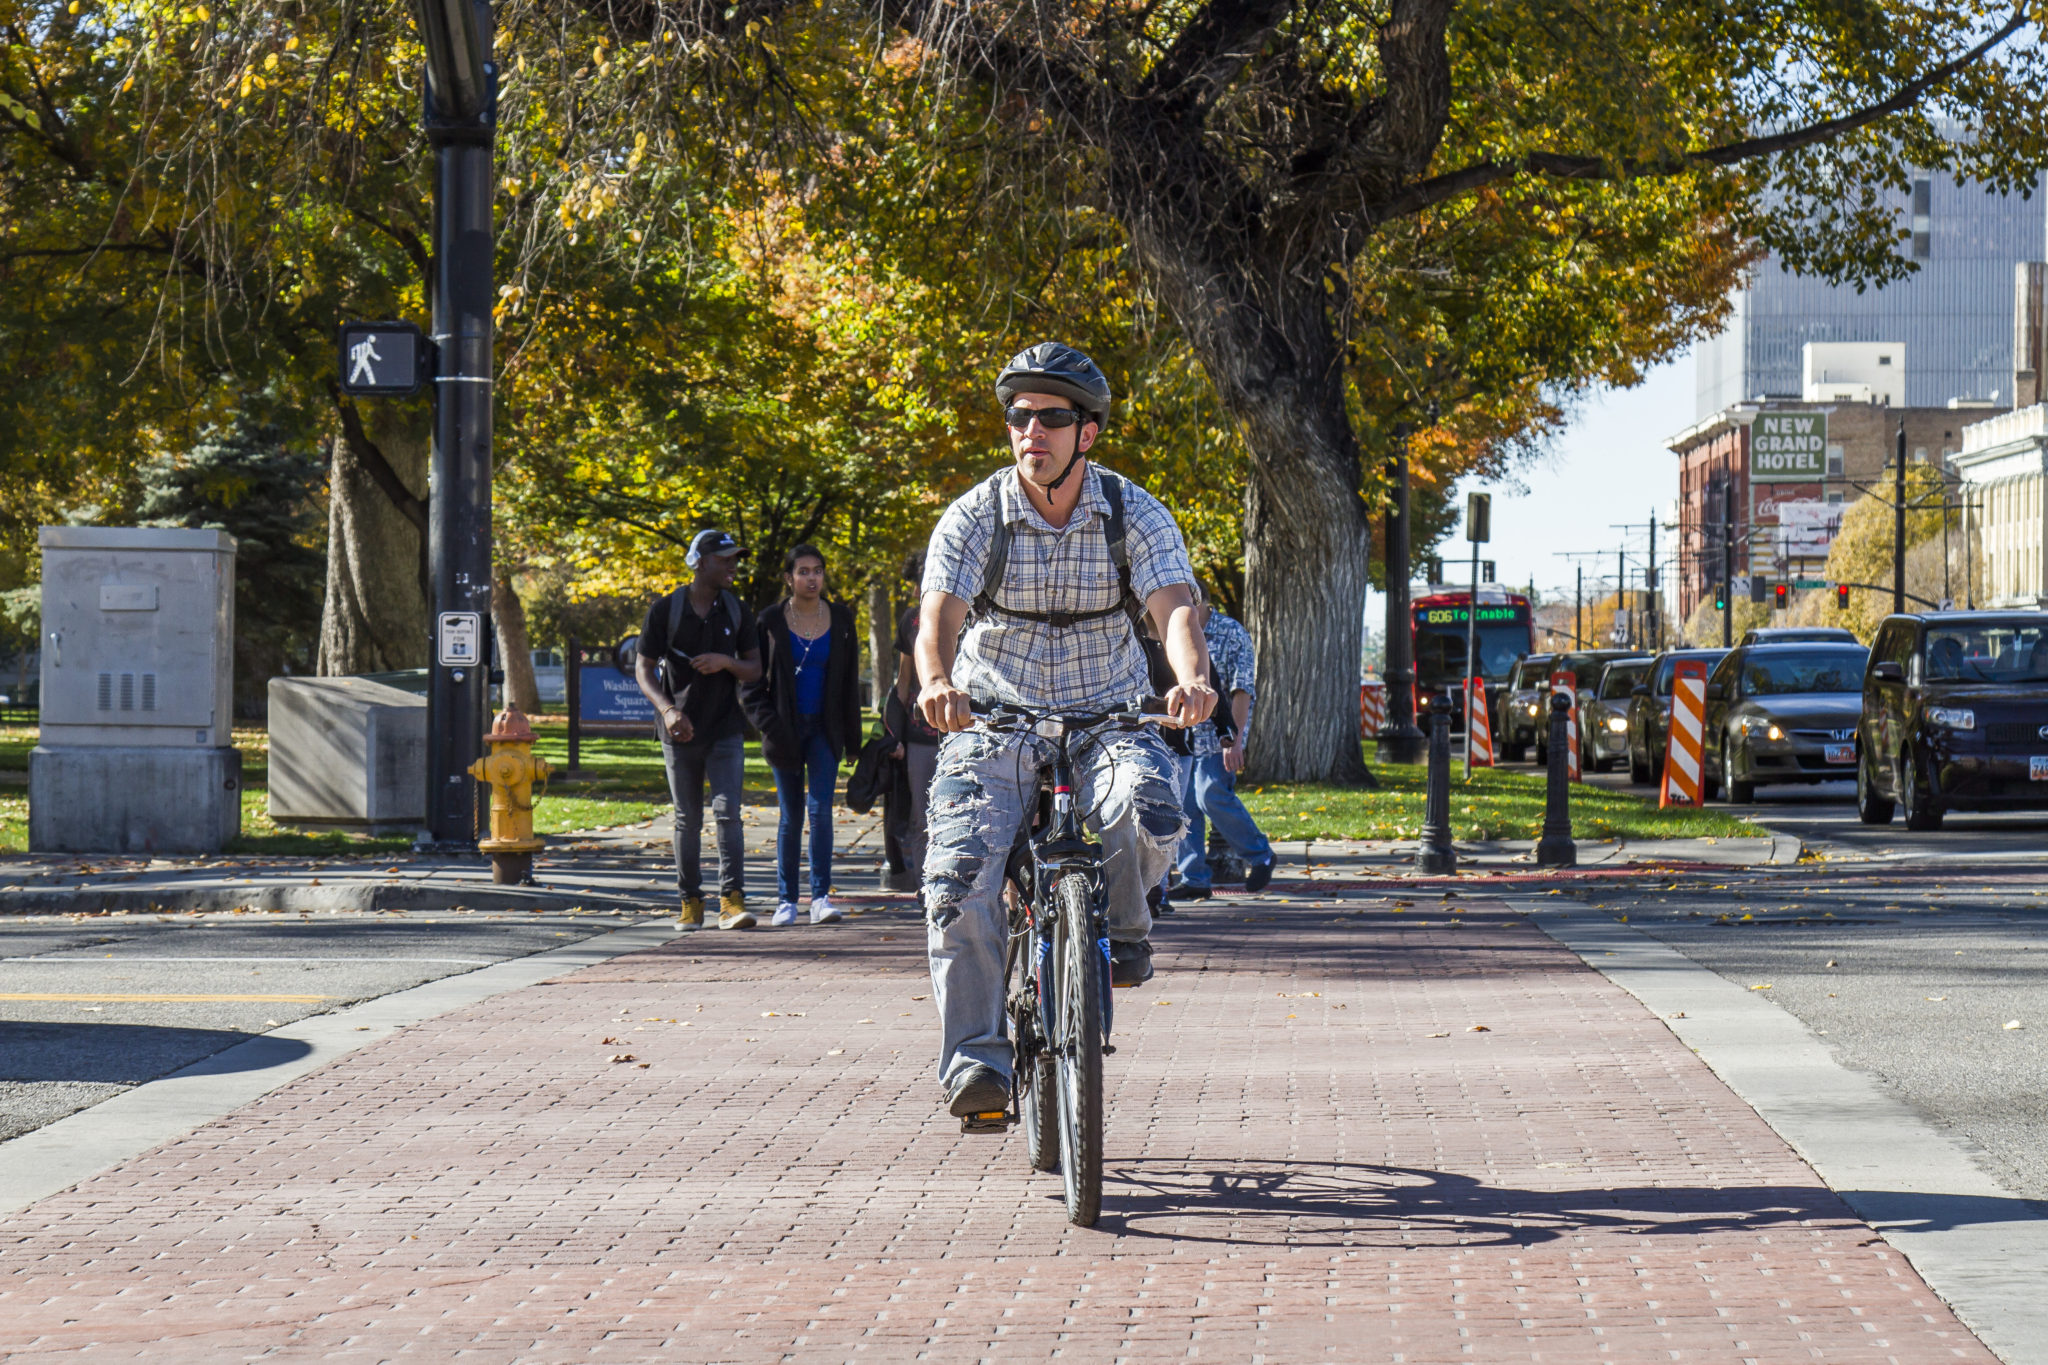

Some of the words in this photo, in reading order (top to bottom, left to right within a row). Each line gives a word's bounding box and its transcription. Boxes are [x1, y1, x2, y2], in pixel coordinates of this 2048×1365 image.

[1764, 417, 1814, 434] NEW
[1755, 435, 1823, 452] GRAND
[1757, 453, 1820, 470] HOTEL
[1453, 608, 1469, 621] To
[615, 694, 648, 709] Square
